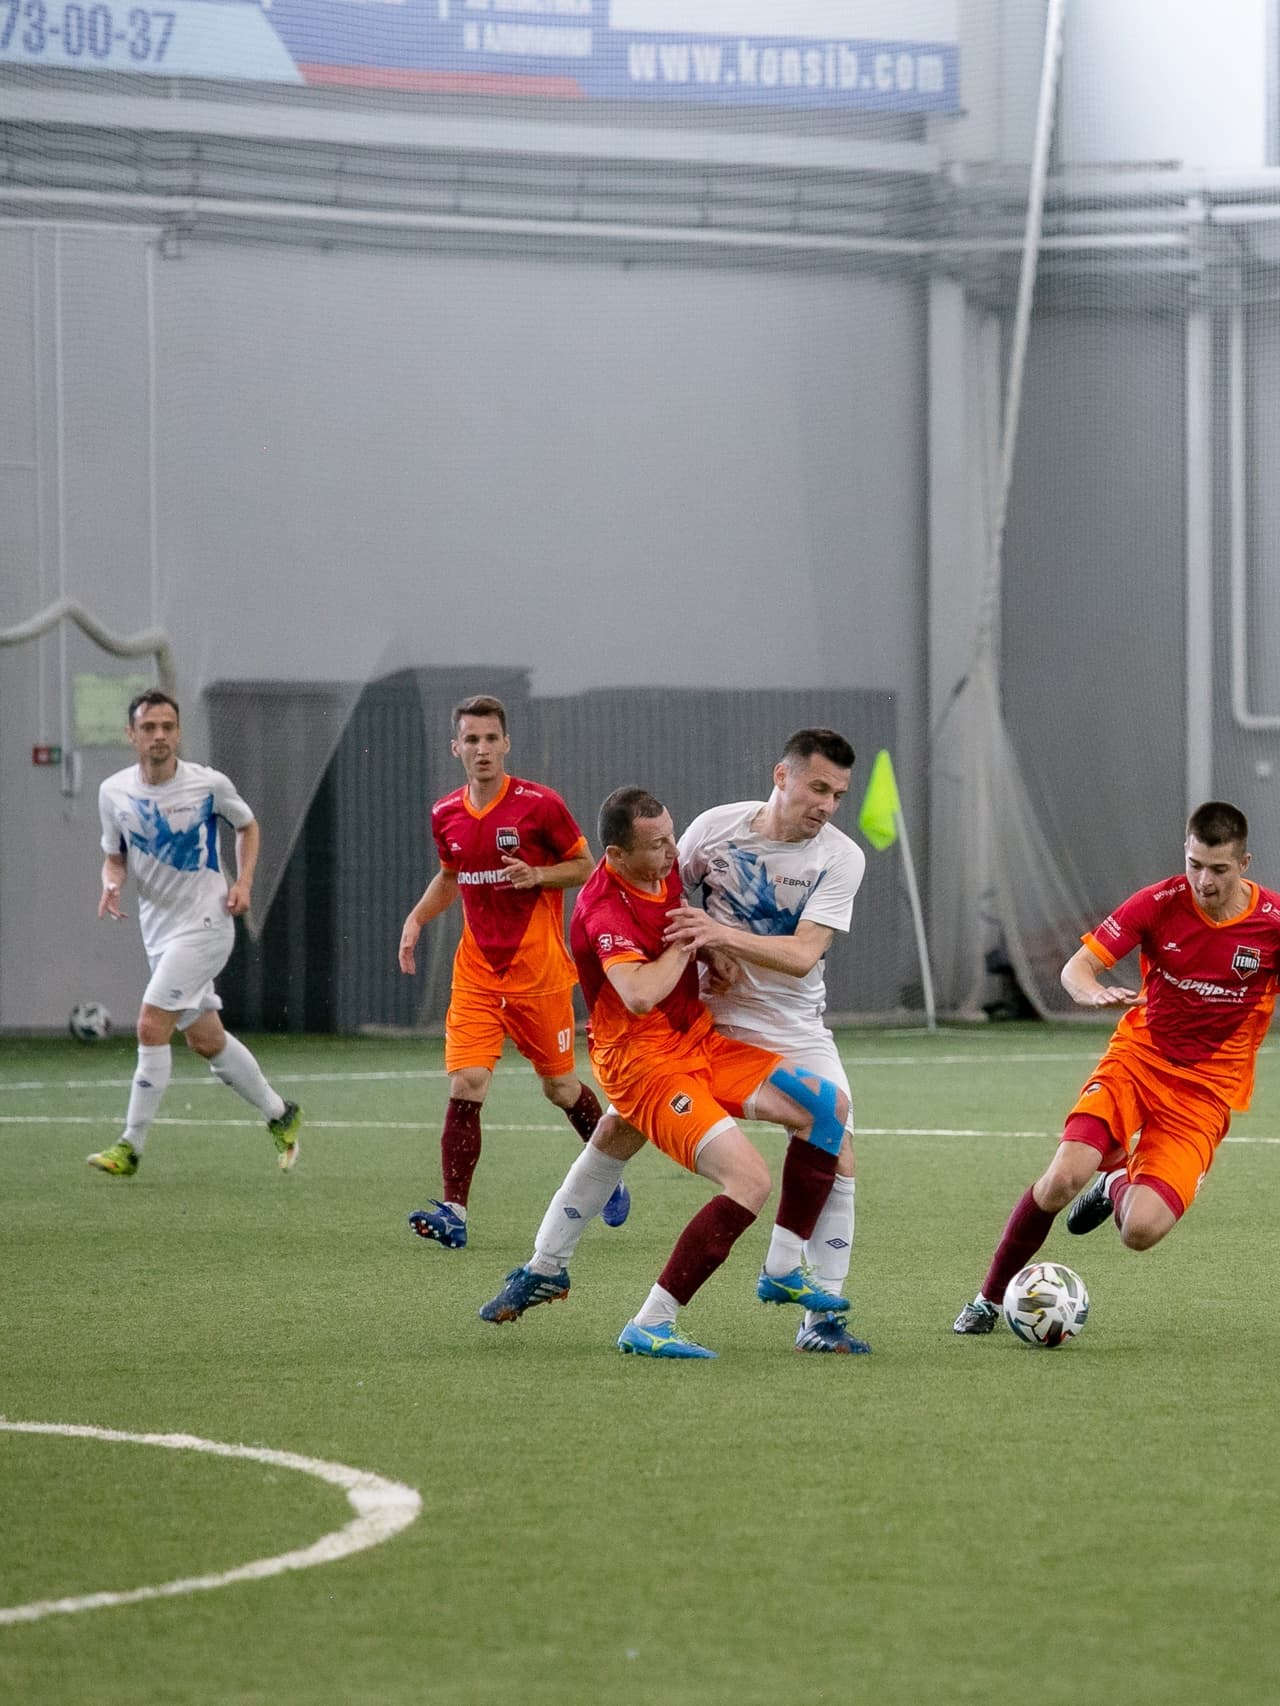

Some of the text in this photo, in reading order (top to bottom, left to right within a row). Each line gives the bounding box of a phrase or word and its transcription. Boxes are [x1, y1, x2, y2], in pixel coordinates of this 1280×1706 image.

[783, 877, 812, 888] ЕВРАЗ
[1236, 955, 1258, 970] ТЕМП
[557, 1028, 571, 1053] 97
